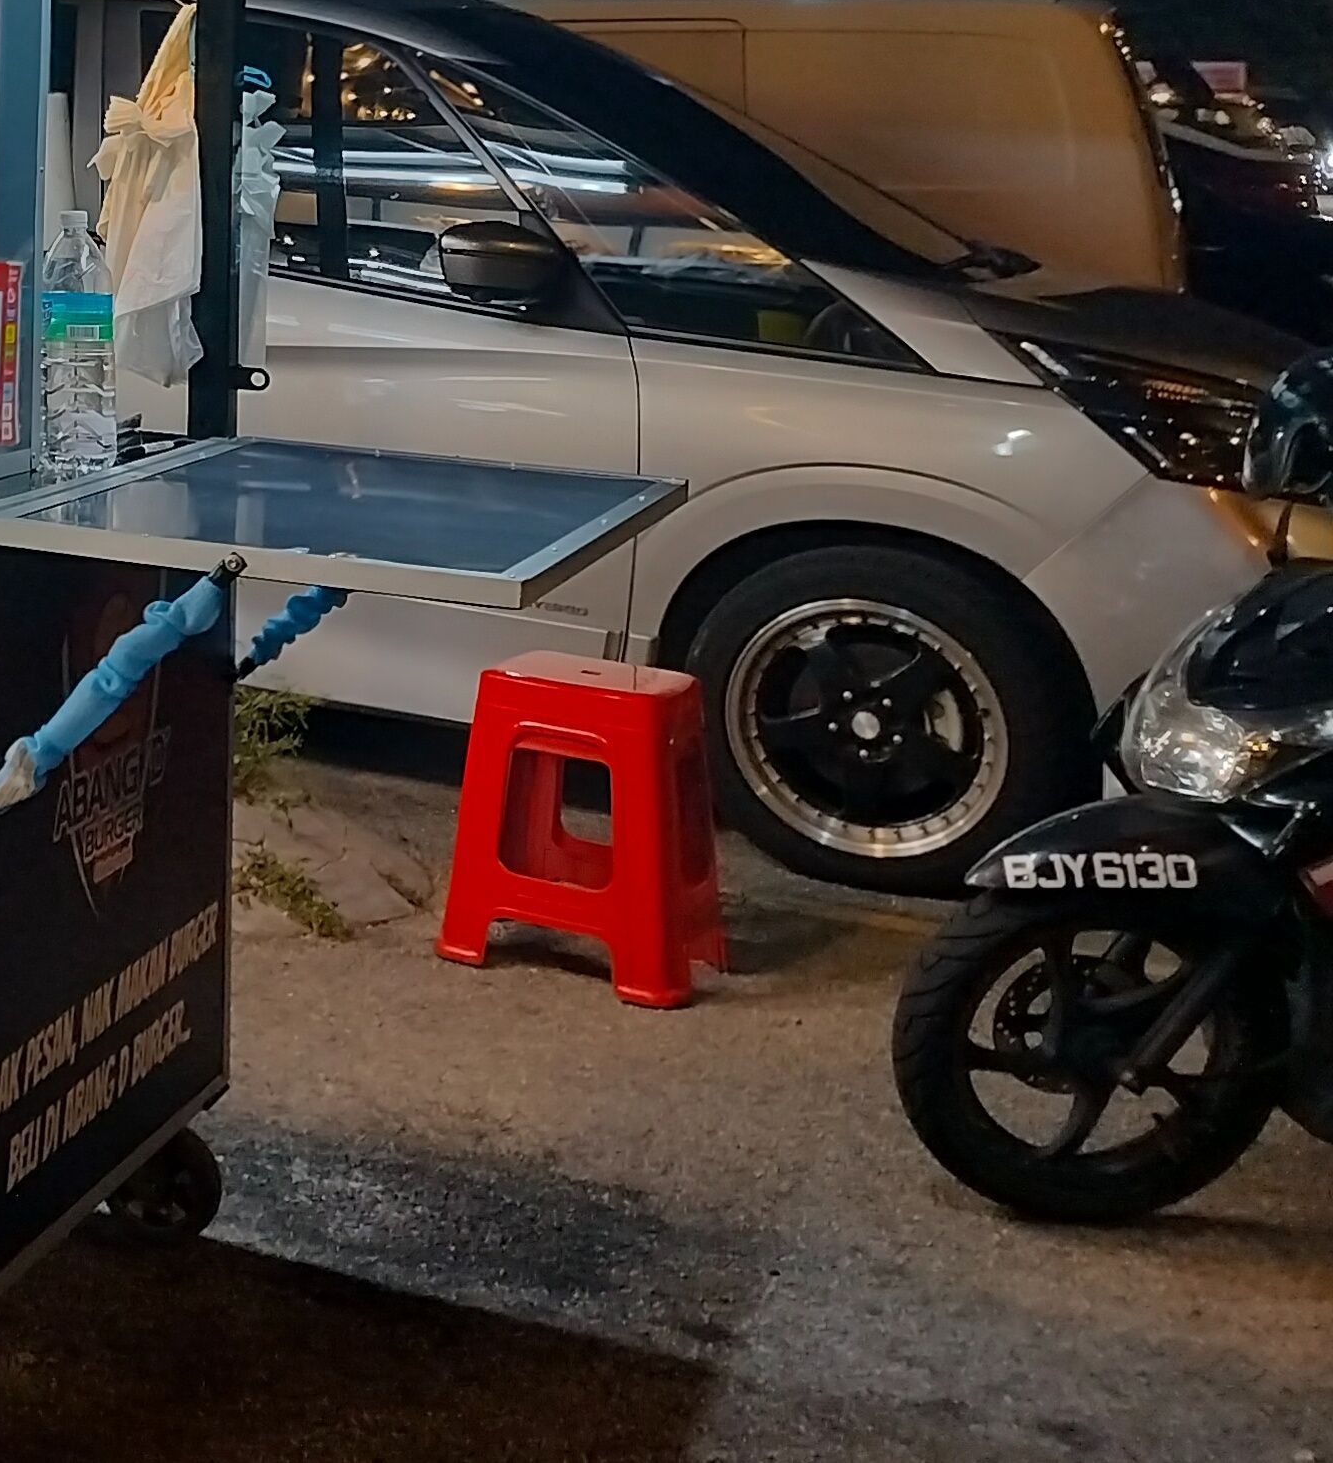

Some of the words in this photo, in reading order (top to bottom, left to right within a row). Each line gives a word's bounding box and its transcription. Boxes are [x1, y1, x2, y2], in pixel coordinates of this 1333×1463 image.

[53, 745, 143, 842] ABANG
[83, 801, 144, 864] BURGER
[1003, 851, 1087, 888] BJY
[1092, 852, 1198, 888] 6130
[168, 901, 219, 981] BURGER
[63, 1054, 116, 1144] ABANG
